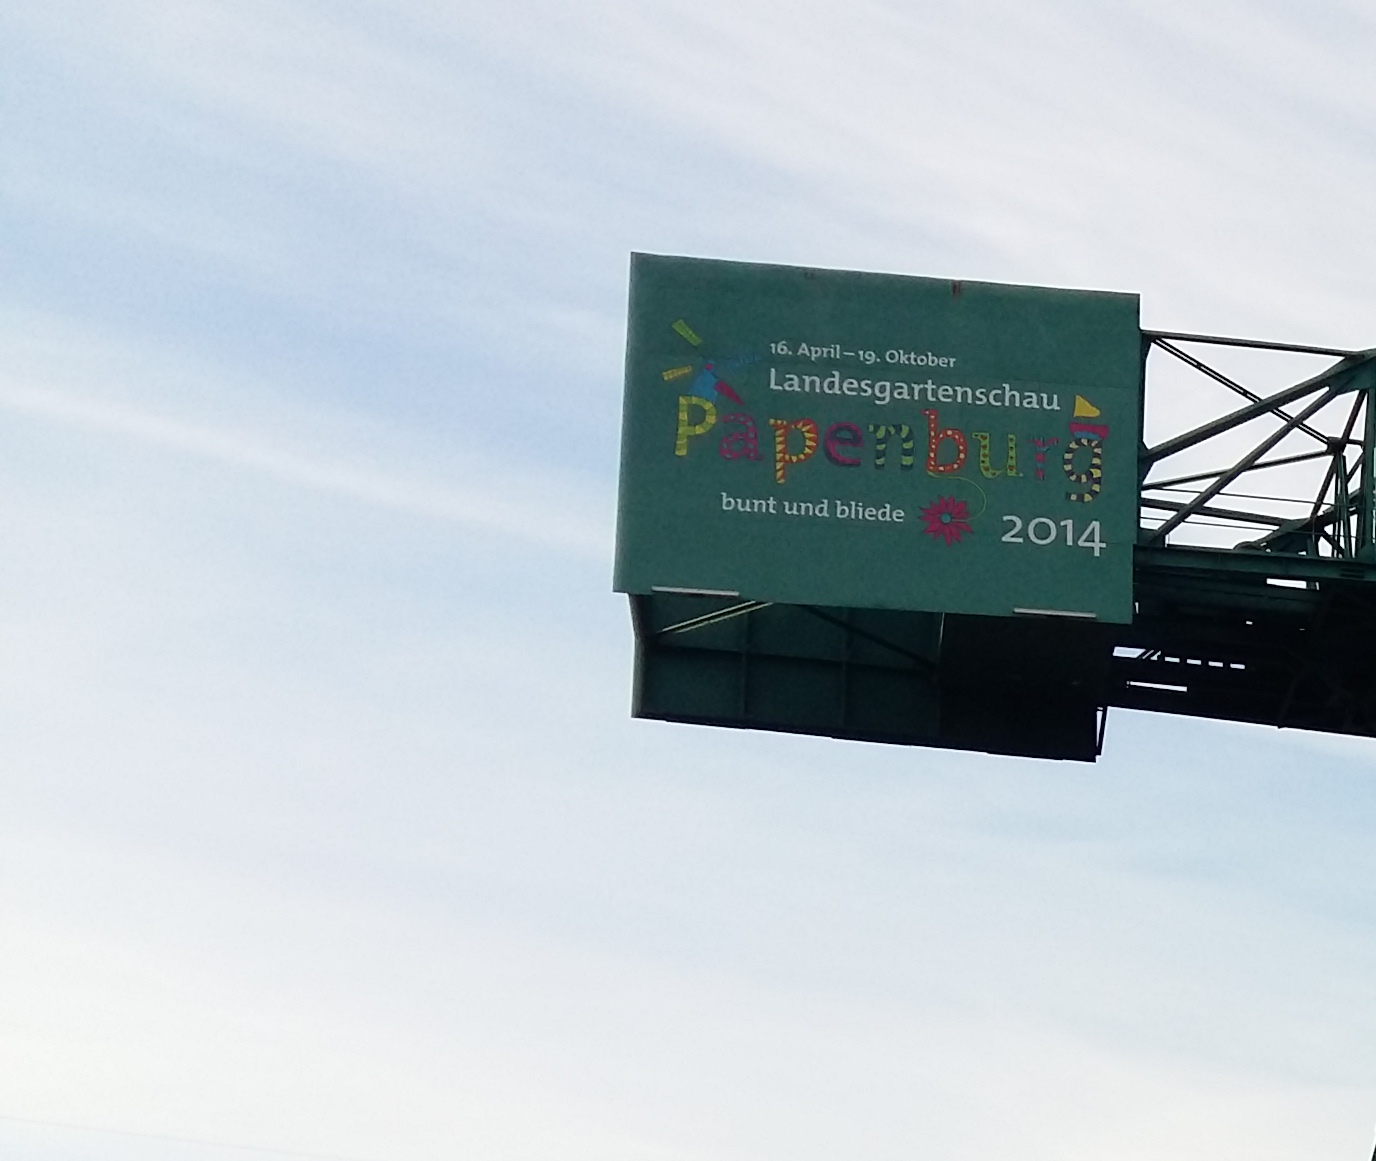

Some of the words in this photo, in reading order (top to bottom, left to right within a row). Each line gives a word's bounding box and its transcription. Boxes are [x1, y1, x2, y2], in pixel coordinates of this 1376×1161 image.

[770, 340, 793, 355] 16.
[885, 350, 956, 368] Oktober
[769, 367, 1061, 411] Landesgartenschau
[674, 395, 1105, 503] Papenburg
[721, 492, 777, 514] bunt
[784, 499, 830, 518] und
[835, 501, 905, 522] bliede
[1001, 514, 1107, 557] 2014
